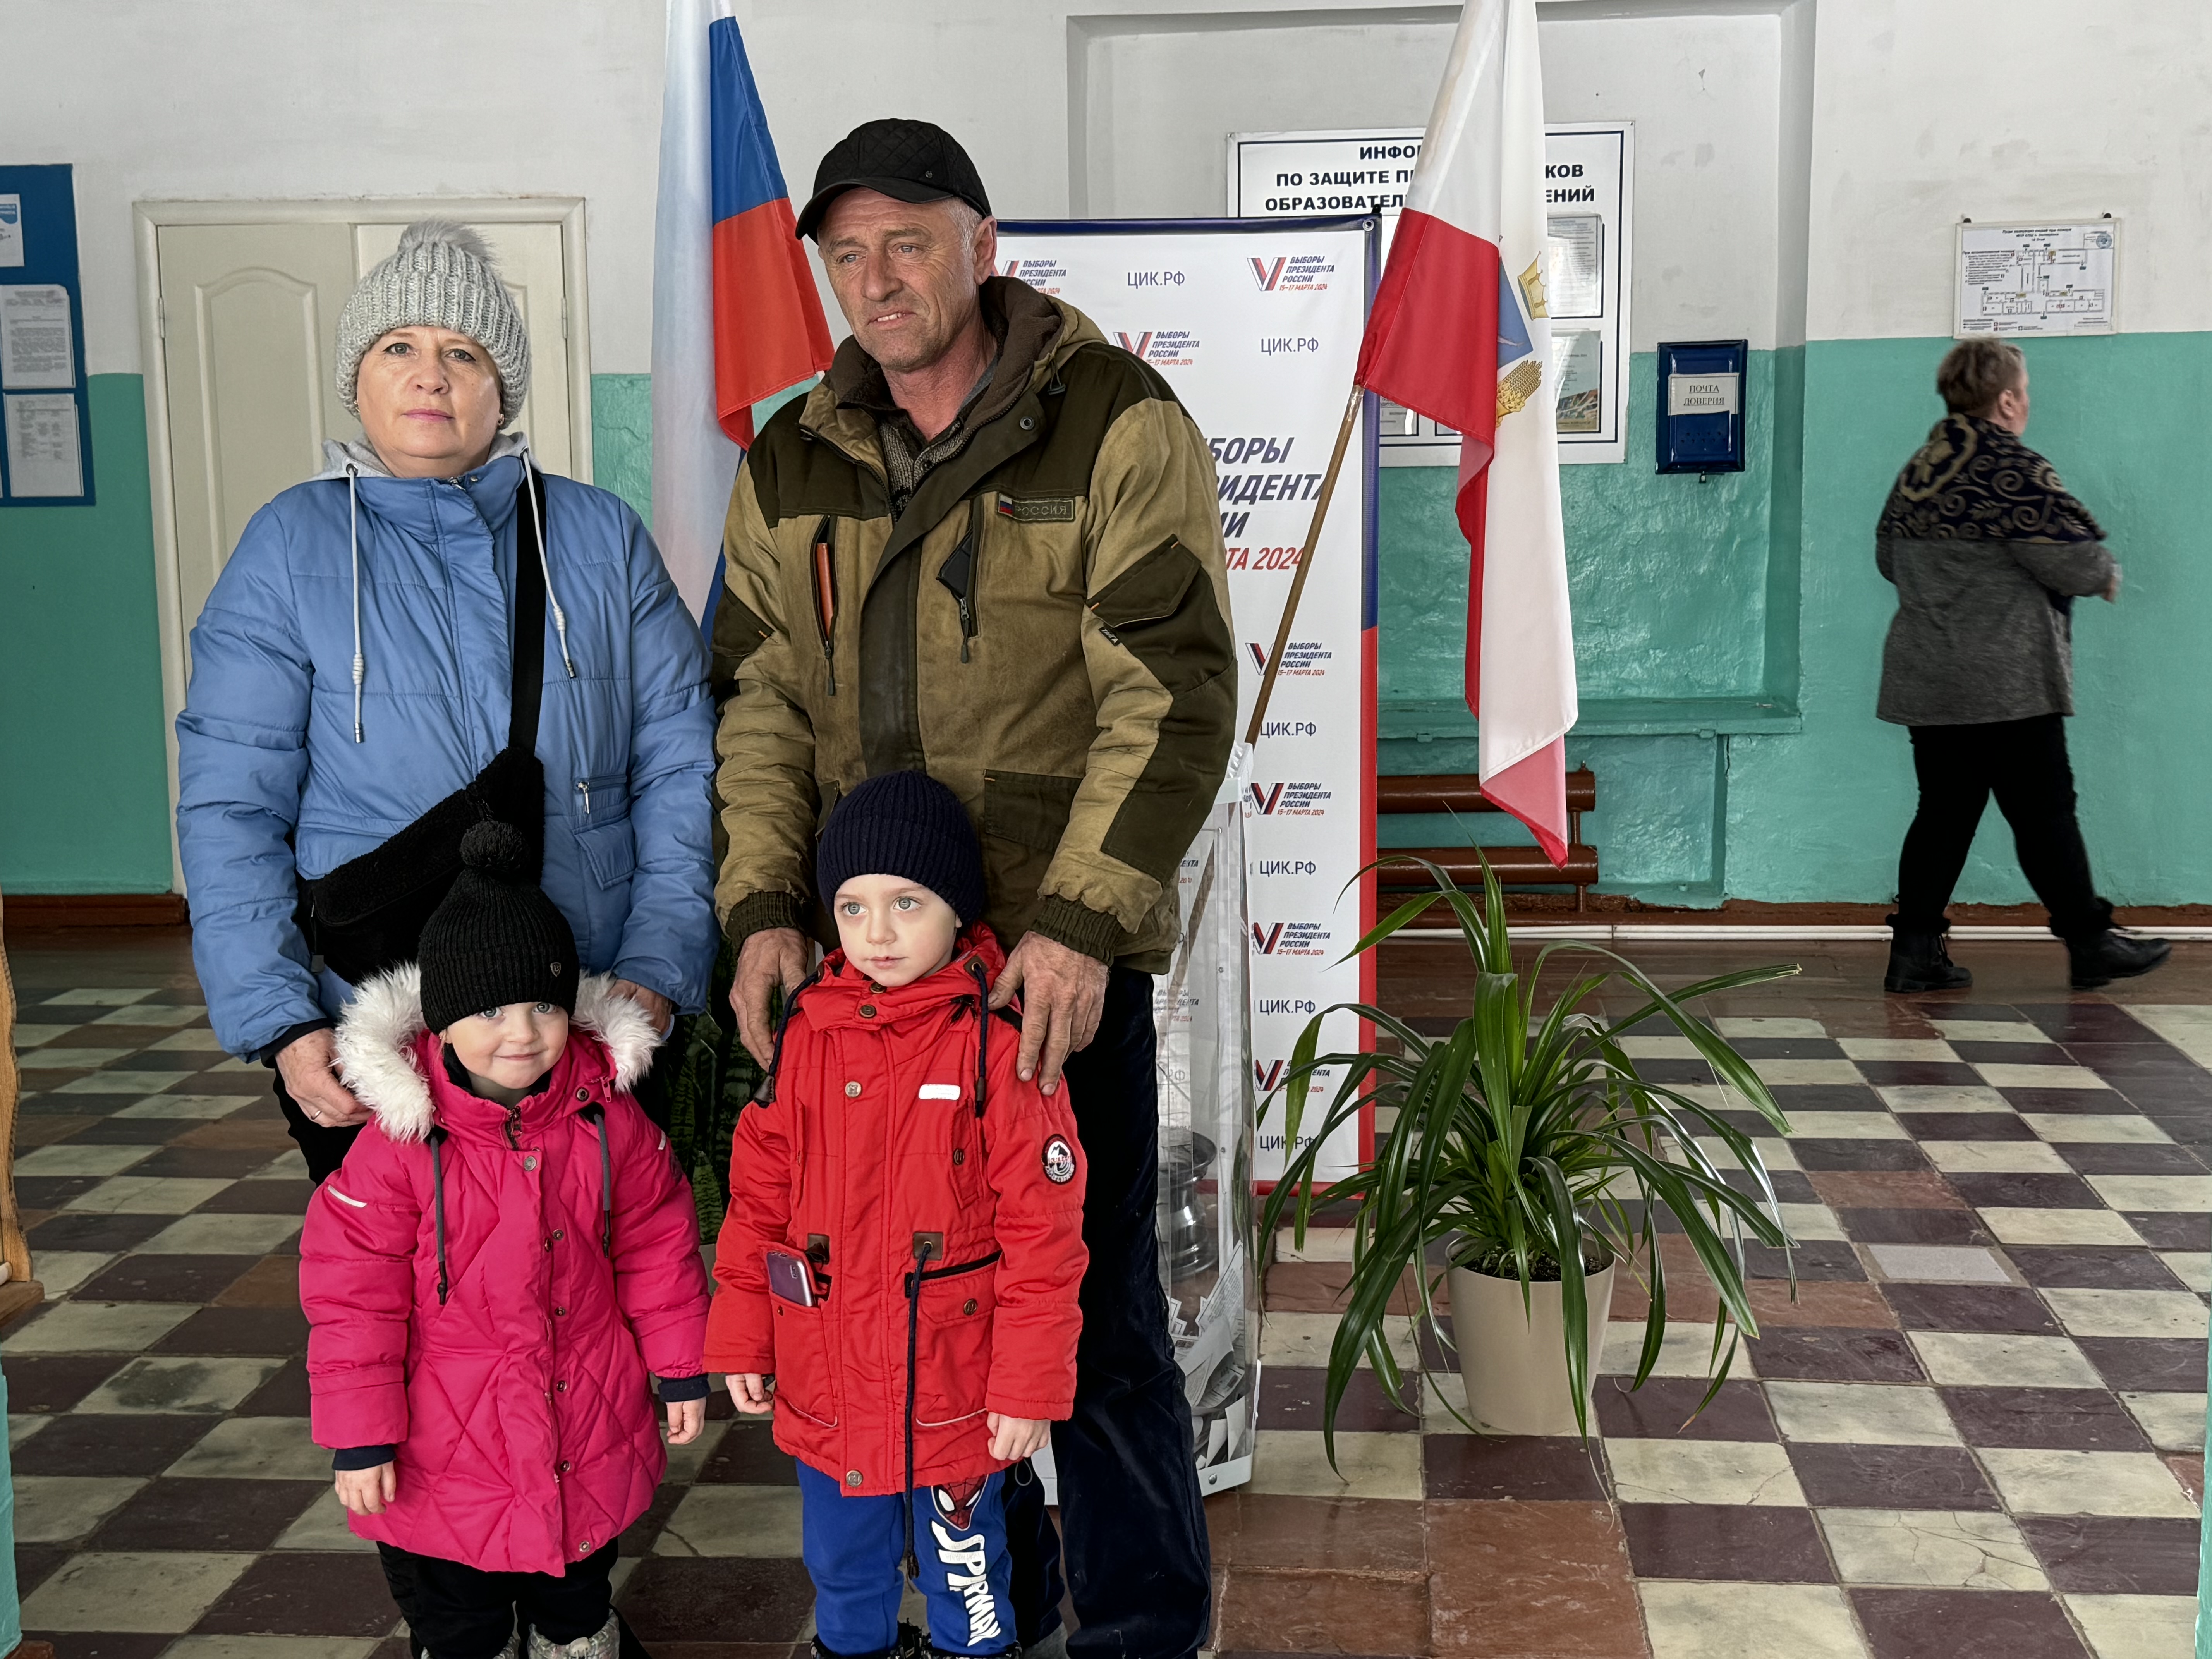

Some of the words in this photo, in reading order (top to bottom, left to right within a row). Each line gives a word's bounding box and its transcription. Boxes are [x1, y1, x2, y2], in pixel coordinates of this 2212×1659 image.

[1277, 173, 1302, 187] ПО
[1309, 170, 1389, 187] ЗАЩИТЕ
[1546, 164, 1583, 178] КОВ
[1265, 194, 1407, 211] ОБРАЗОВАТЕЛ
[1546, 185, 1594, 203] ЕНИЙ
[1019, 269, 1066, 277] ПРЕЗИДЕНТА
[1286, 265, 1334, 273] ПРЕЗИДЕНТА
[1128, 271, 1185, 289] ЦИК.РФ
[1152, 340, 1200, 349] ПРЕЗИДЕНТА
[1261, 337, 1319, 356] ЦИК.РФ
[1689, 385, 1719, 393] ПОЧТА
[1683, 397, 1724, 406] ДОВЕРИЯ
[1205, 437, 1294, 464] БОРЫ
[1015, 505, 1066, 516] РОССИЯ
[1260, 722, 1316, 739] ЦИК.РФ
[1260, 860, 1316, 878] ЦИК.РФ
[1260, 1000, 1316, 1016] ЦИК.РФ
